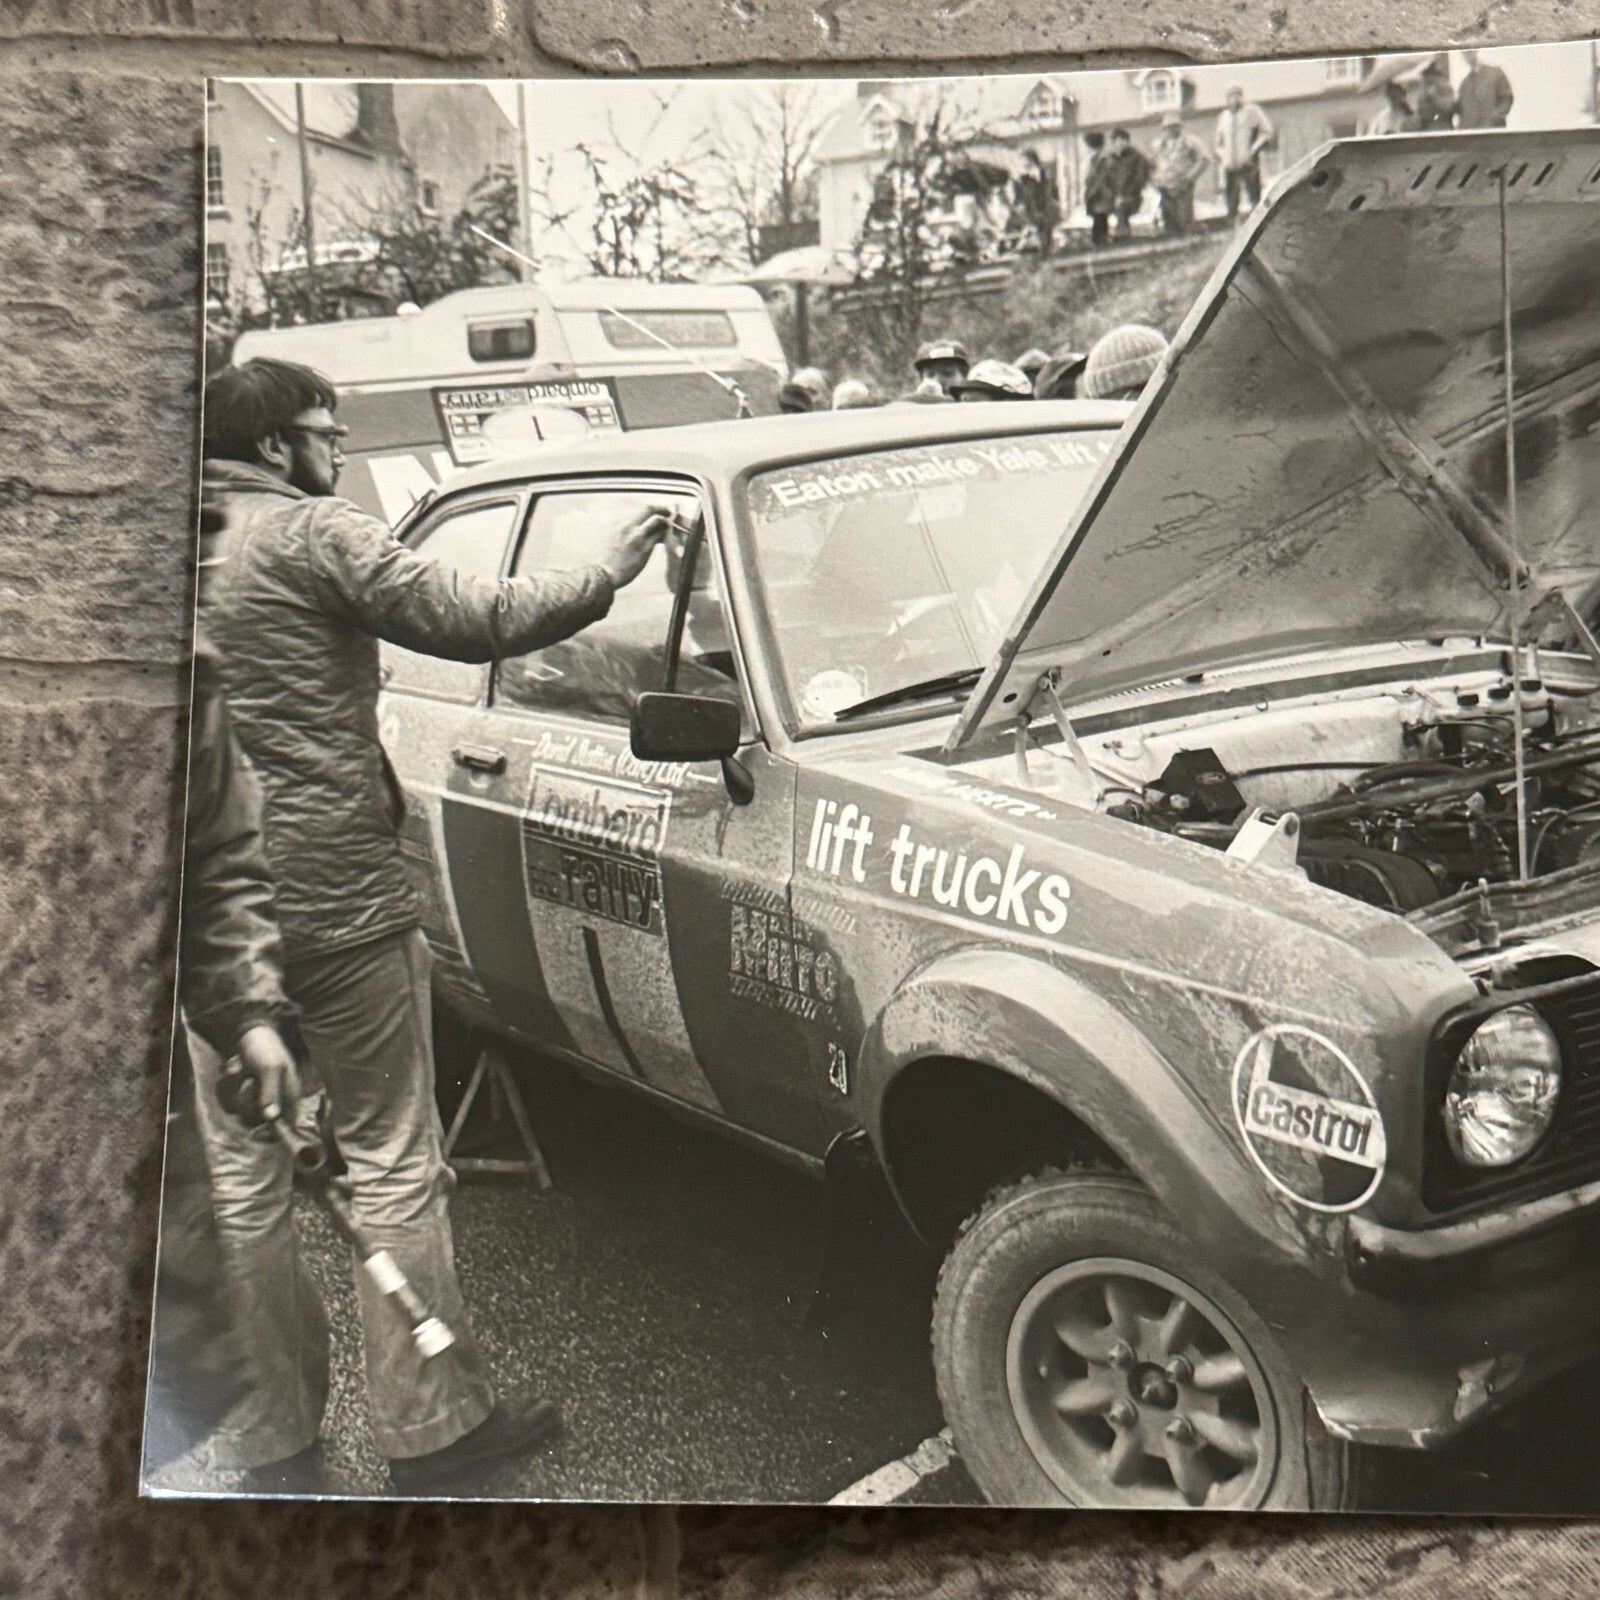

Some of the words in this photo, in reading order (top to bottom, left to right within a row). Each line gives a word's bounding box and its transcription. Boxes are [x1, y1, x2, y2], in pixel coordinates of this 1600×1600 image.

[771, 471, 878, 508] Eaton
[891, 453, 978, 486] make
[975, 442, 1050, 475] Yale
[1047, 440, 1099, 465] lift
[561, 854, 659, 929] rally
[806, 799, 874, 883] lift
[890, 824, 1071, 934] trucks
[1250, 1085, 1373, 1157] Castrol
